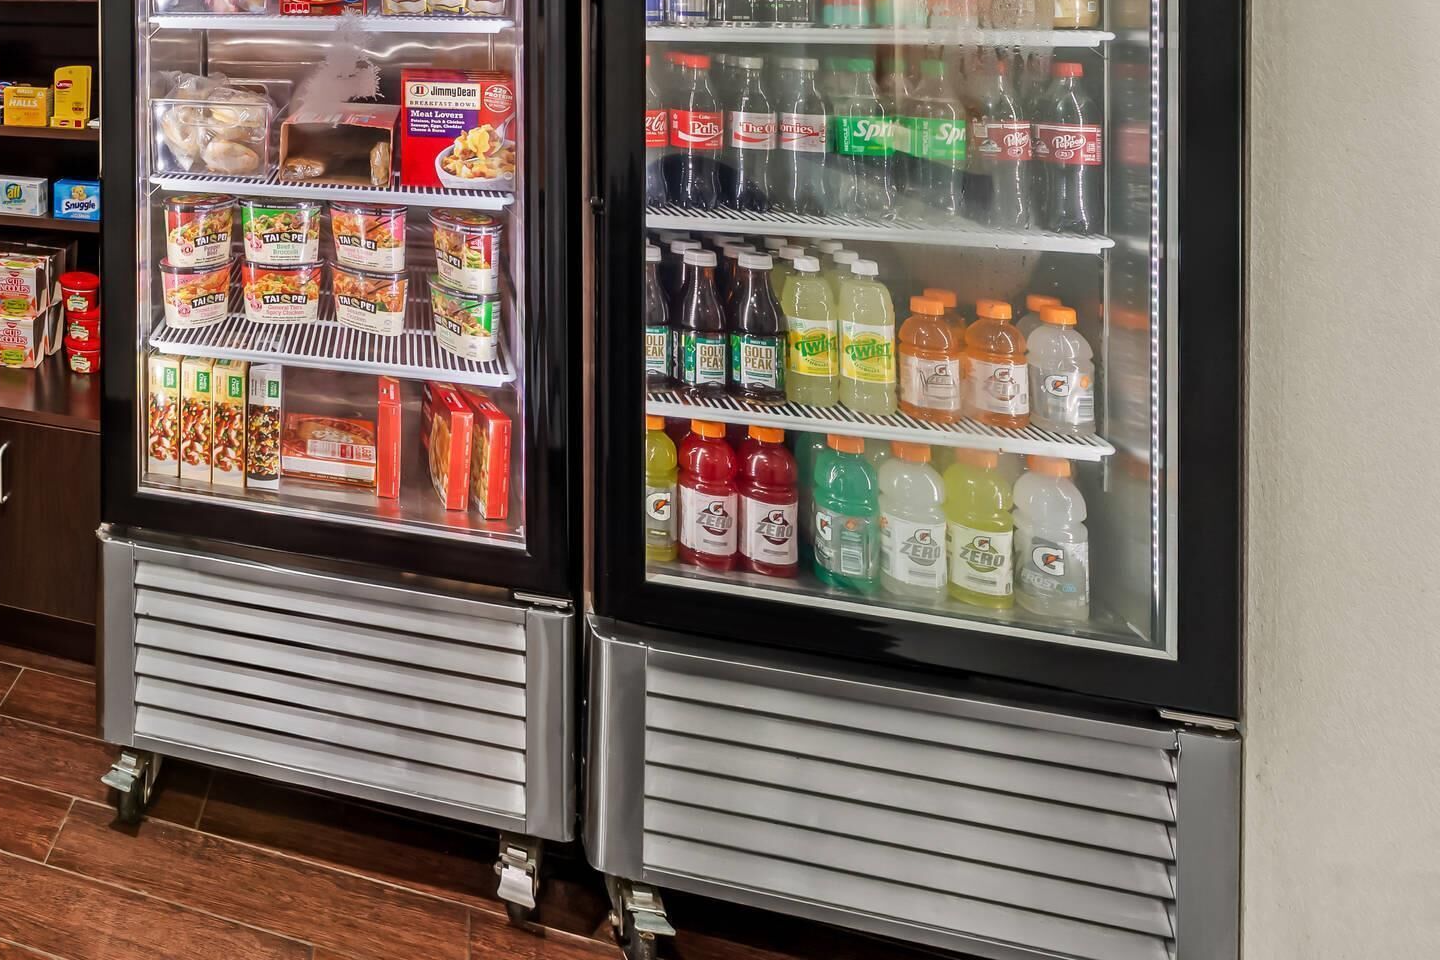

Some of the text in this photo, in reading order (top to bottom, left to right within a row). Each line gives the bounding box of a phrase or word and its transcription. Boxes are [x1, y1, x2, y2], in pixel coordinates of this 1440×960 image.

[430, 85, 477, 98] Jimmy Dean
[484, 91, 513, 101] PROTEIN
[8, 97, 39, 109] HALLS
[410, 109, 465, 120] Meat Lovers
[690, 121, 720, 136] Pals
[741, 122, 764, 135] The
[6, 184, 20, 199] all
[64, 200, 96, 212] Snuggle
[263, 233, 307, 243] TAI PEI
[262, 294, 308, 304] TAI PEI
[339, 295, 376, 312] TAI PEI
[4, 327, 22, 337] CUP
[700, 345, 724, 357] GOLD
[744, 346, 773, 359] GOLD
[700, 357, 724, 369] PEAK
[744, 357, 773, 370] PEAK
[694, 510, 733, 530] ZERO
[755, 518, 793, 537] ZERO
[899, 542, 941, 559] ZERO
[960, 546, 1005, 567] ZERO
